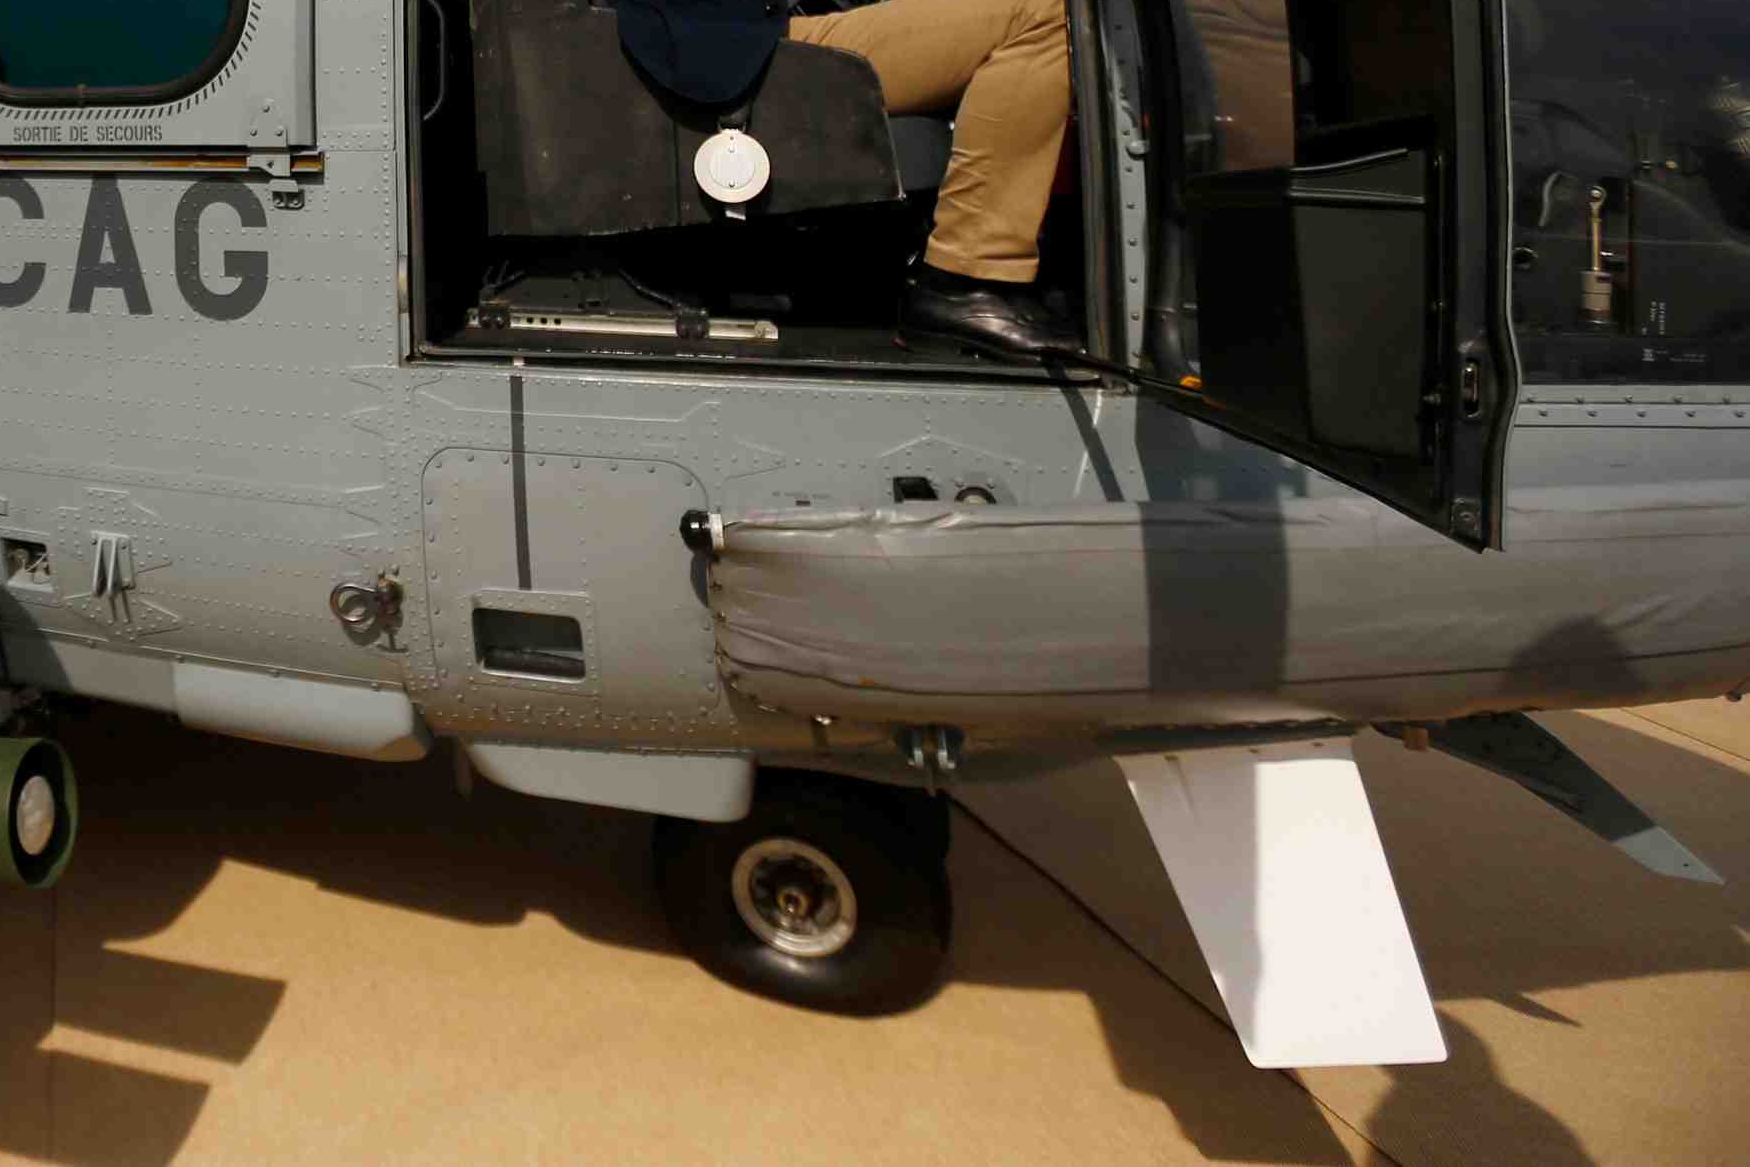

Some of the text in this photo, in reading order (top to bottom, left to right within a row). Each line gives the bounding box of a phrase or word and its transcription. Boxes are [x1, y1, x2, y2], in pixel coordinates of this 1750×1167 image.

[12, 124, 163, 142] SORTIE DE SECOURS
